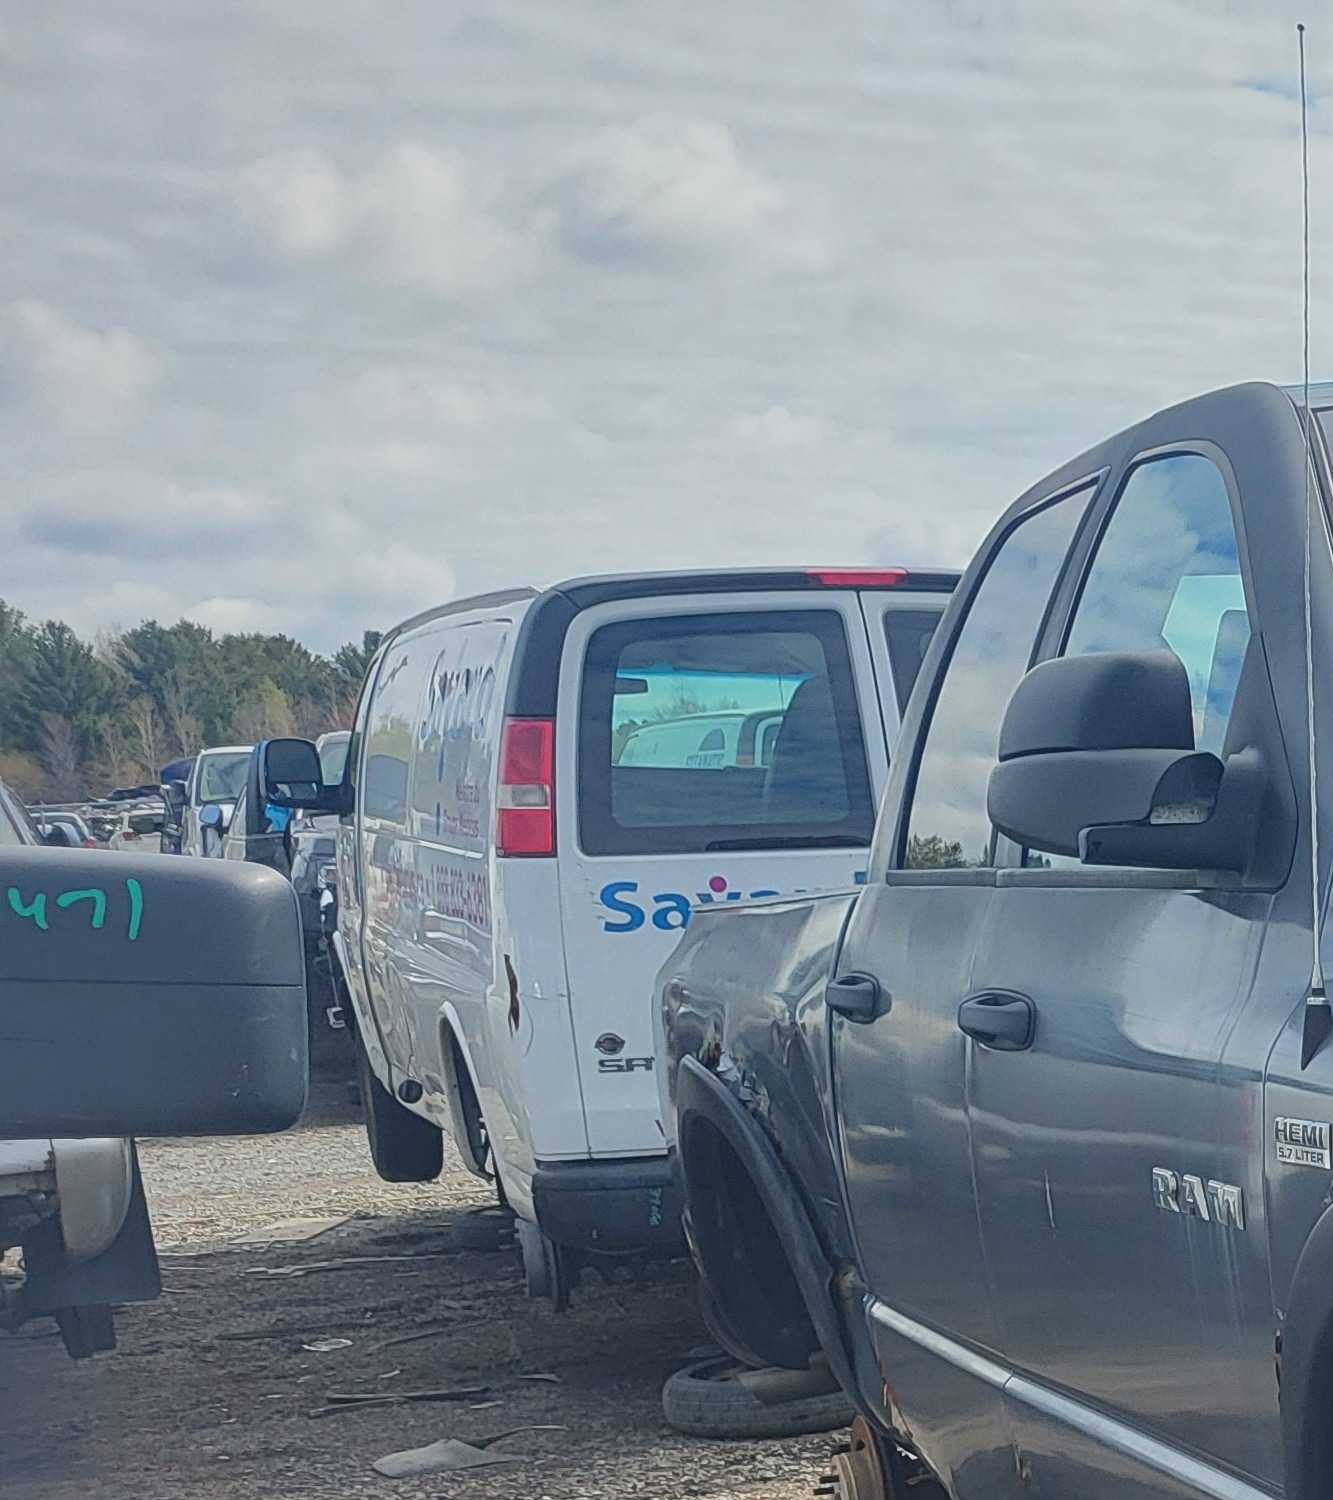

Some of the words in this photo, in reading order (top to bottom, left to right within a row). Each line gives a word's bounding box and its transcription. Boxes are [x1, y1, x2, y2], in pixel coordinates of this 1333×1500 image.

[8, 878, 143, 940] 471
[597, 1056, 655, 1073] SA
[1274, 1119, 1325, 1149] HEMI
[1278, 1147, 1293, 1160] 5.7
[1295, 1149, 1325, 1164] LITER
[1152, 1166, 1245, 1231] RAM
